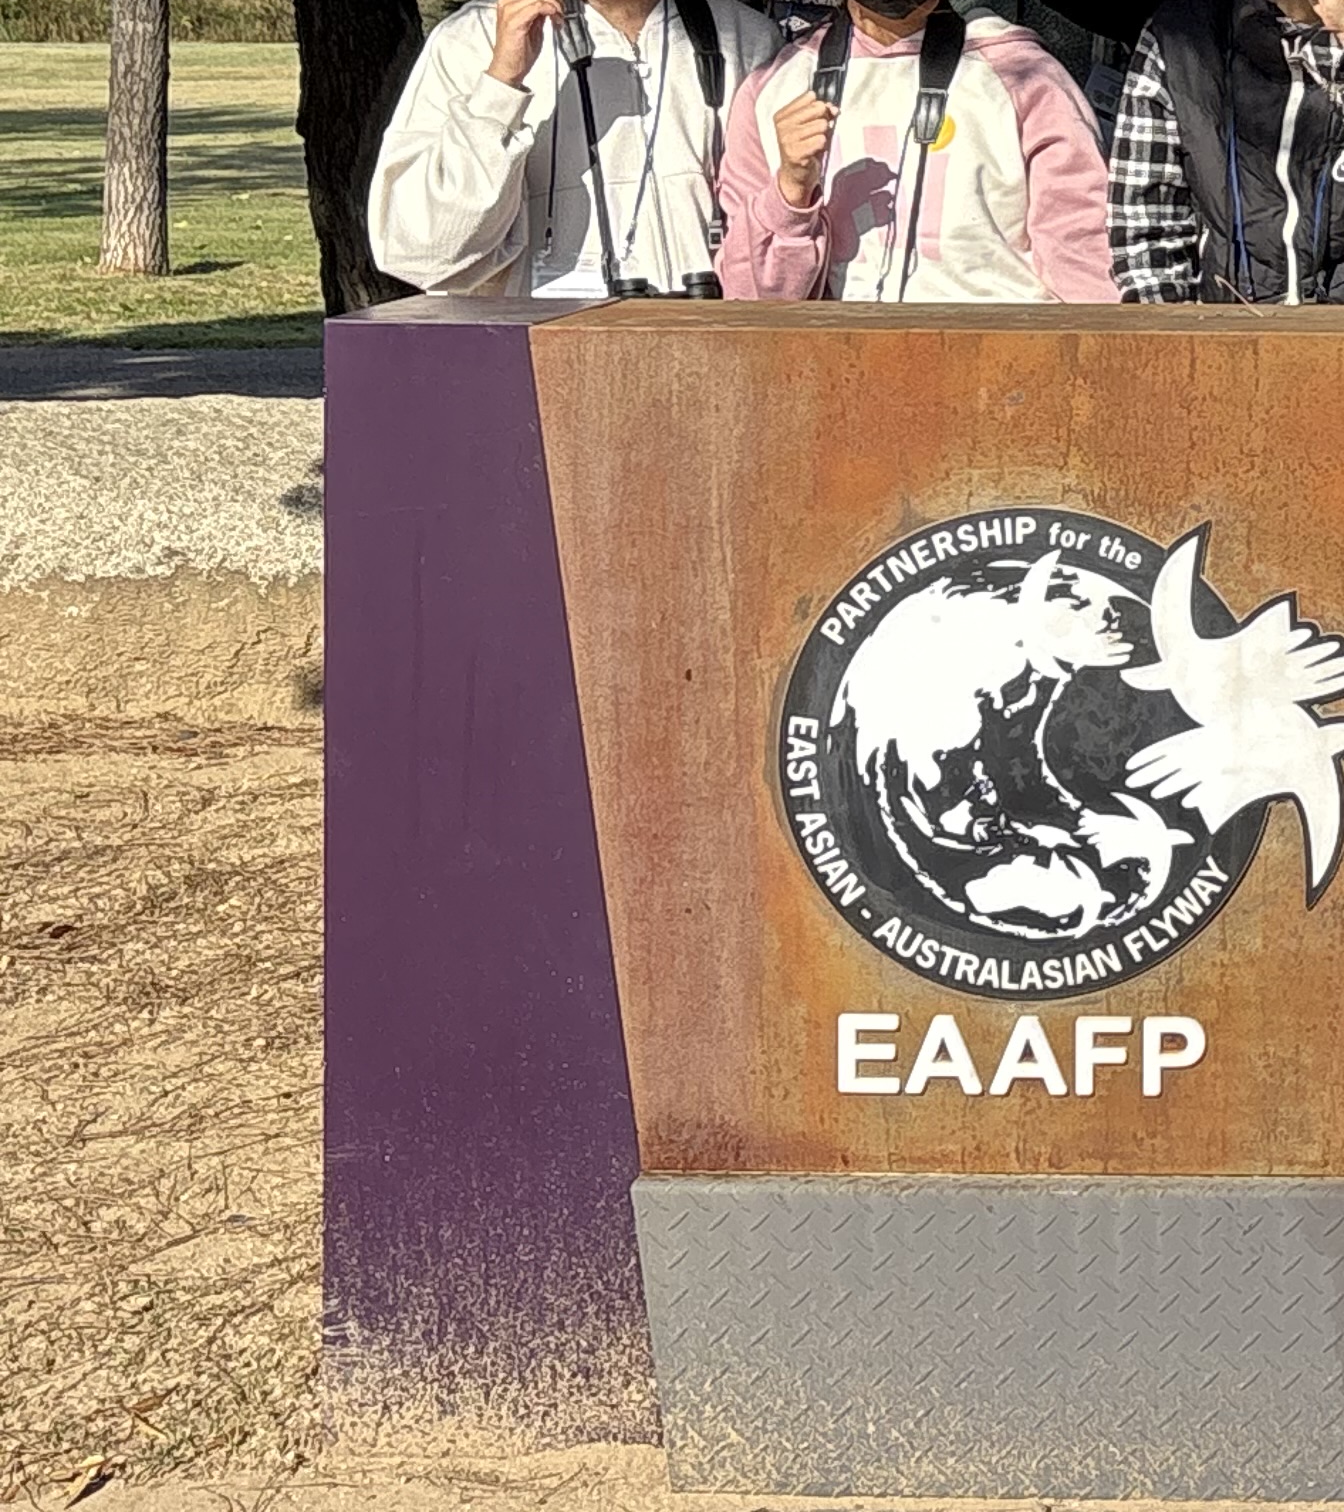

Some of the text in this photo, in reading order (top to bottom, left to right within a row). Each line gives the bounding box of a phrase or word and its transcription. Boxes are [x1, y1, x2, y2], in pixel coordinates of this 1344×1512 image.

[819, 515, 1143, 646] PARTNERSHIP for the
[785, 715, 821, 801] EAST
[795, 809, 867, 908] ASIAN
[872, 915, 1124, 991] AUSTRALASIAN
[1123, 854, 1230, 963] FLYWAY
[836, 1011, 1208, 1098] EAAFP
